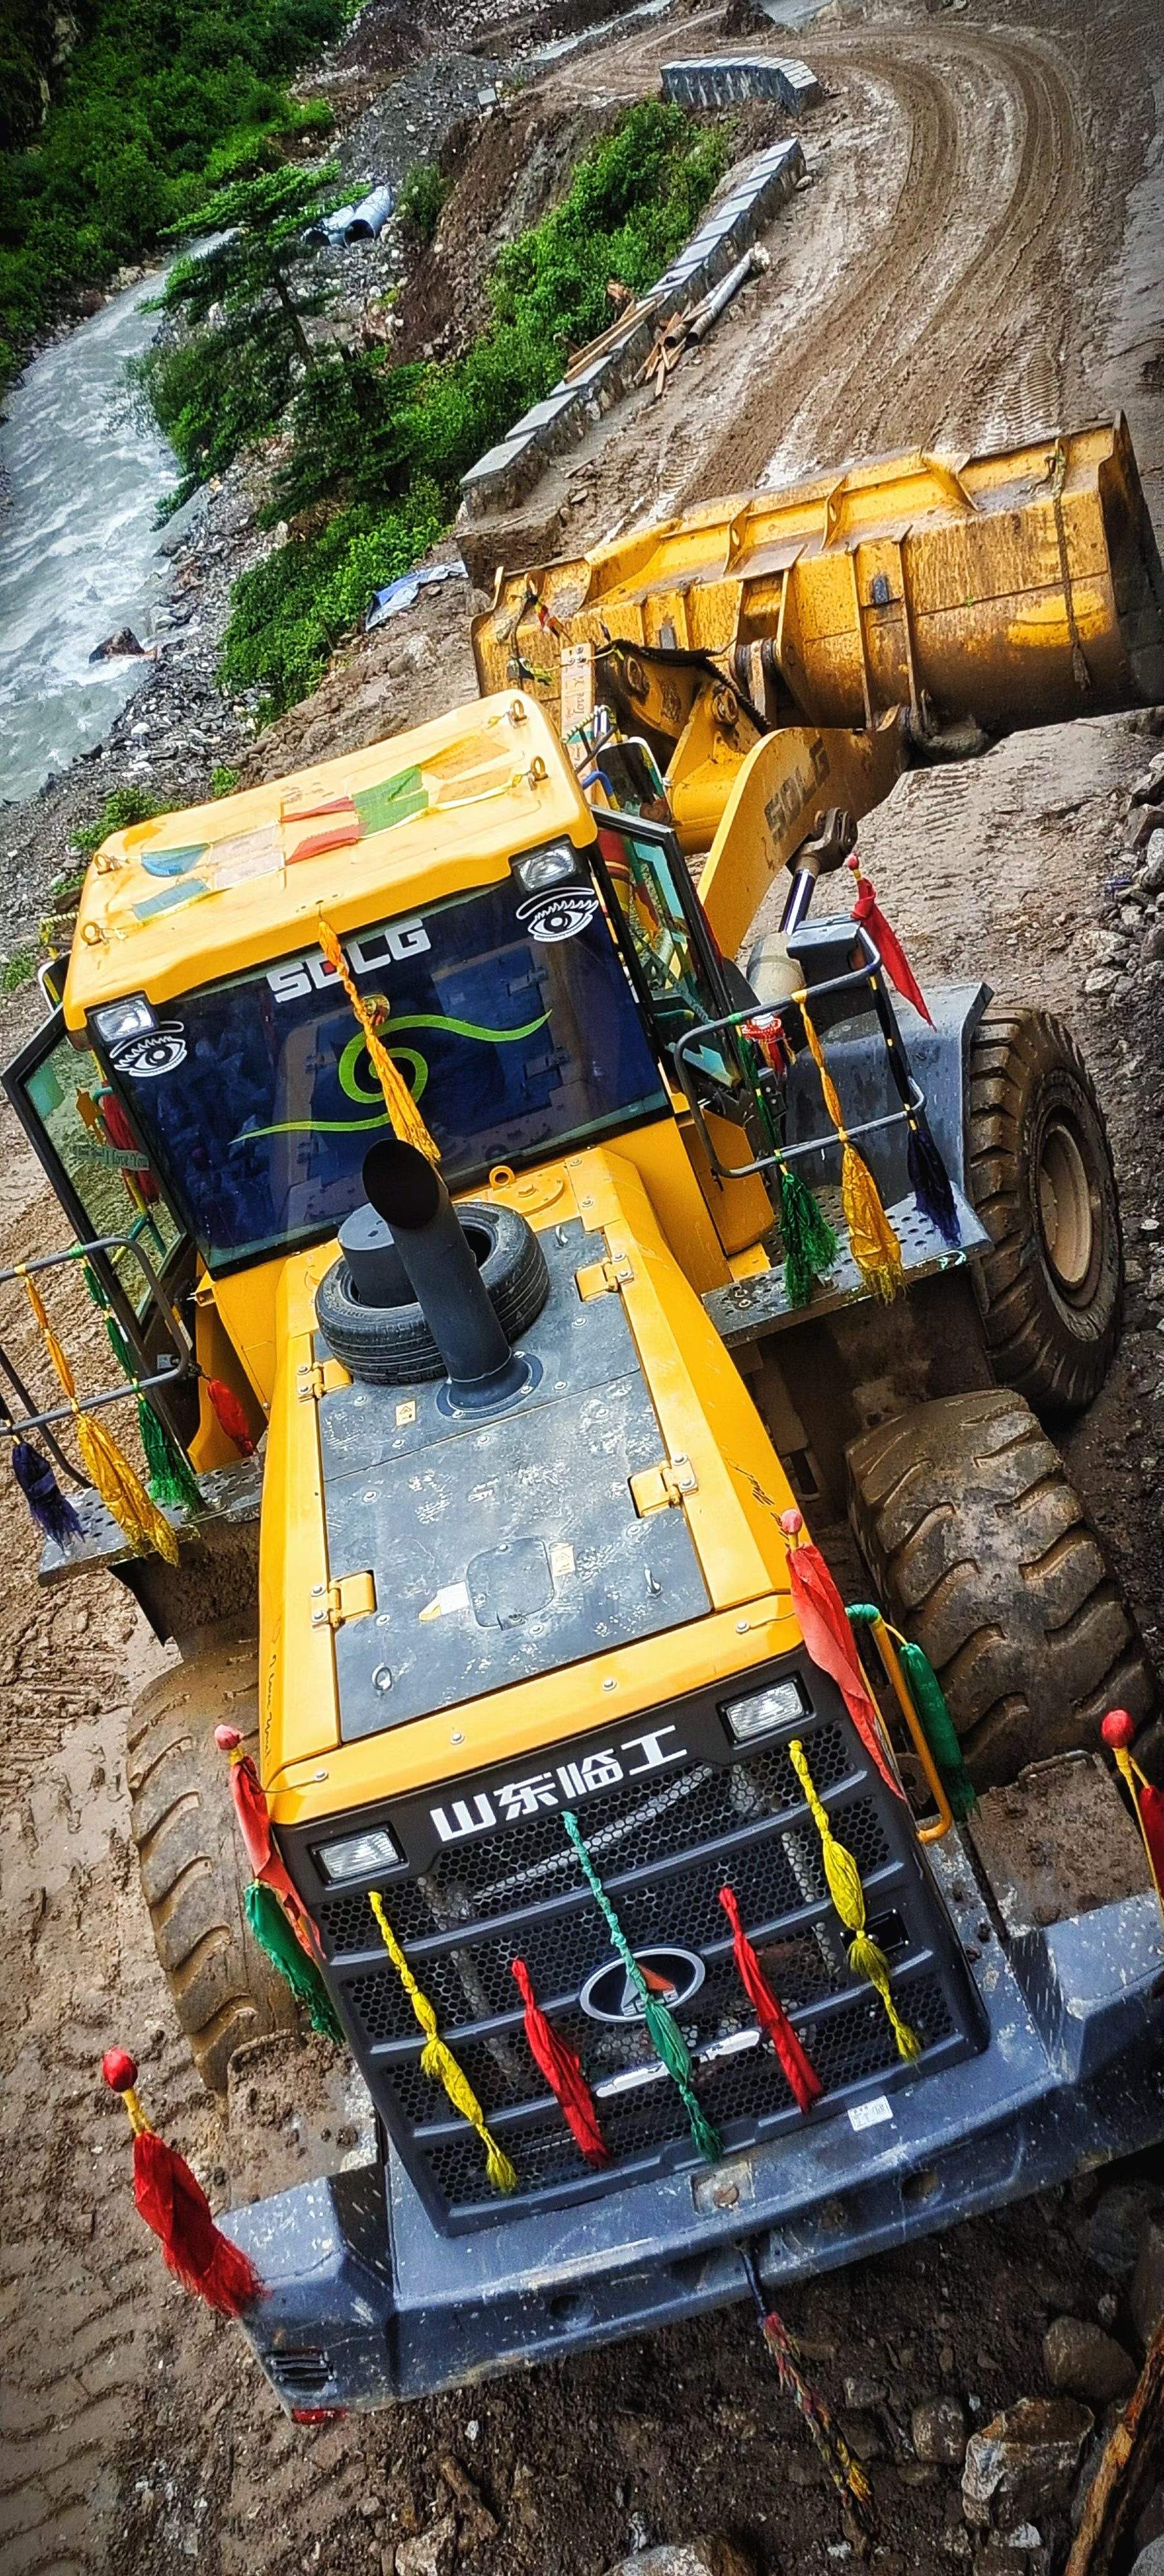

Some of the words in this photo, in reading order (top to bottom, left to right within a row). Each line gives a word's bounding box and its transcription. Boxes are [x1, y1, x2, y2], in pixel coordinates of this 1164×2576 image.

[266, 918, 431, 1003] SDLG
[429, 1725, 688, 1842] 山东临工
